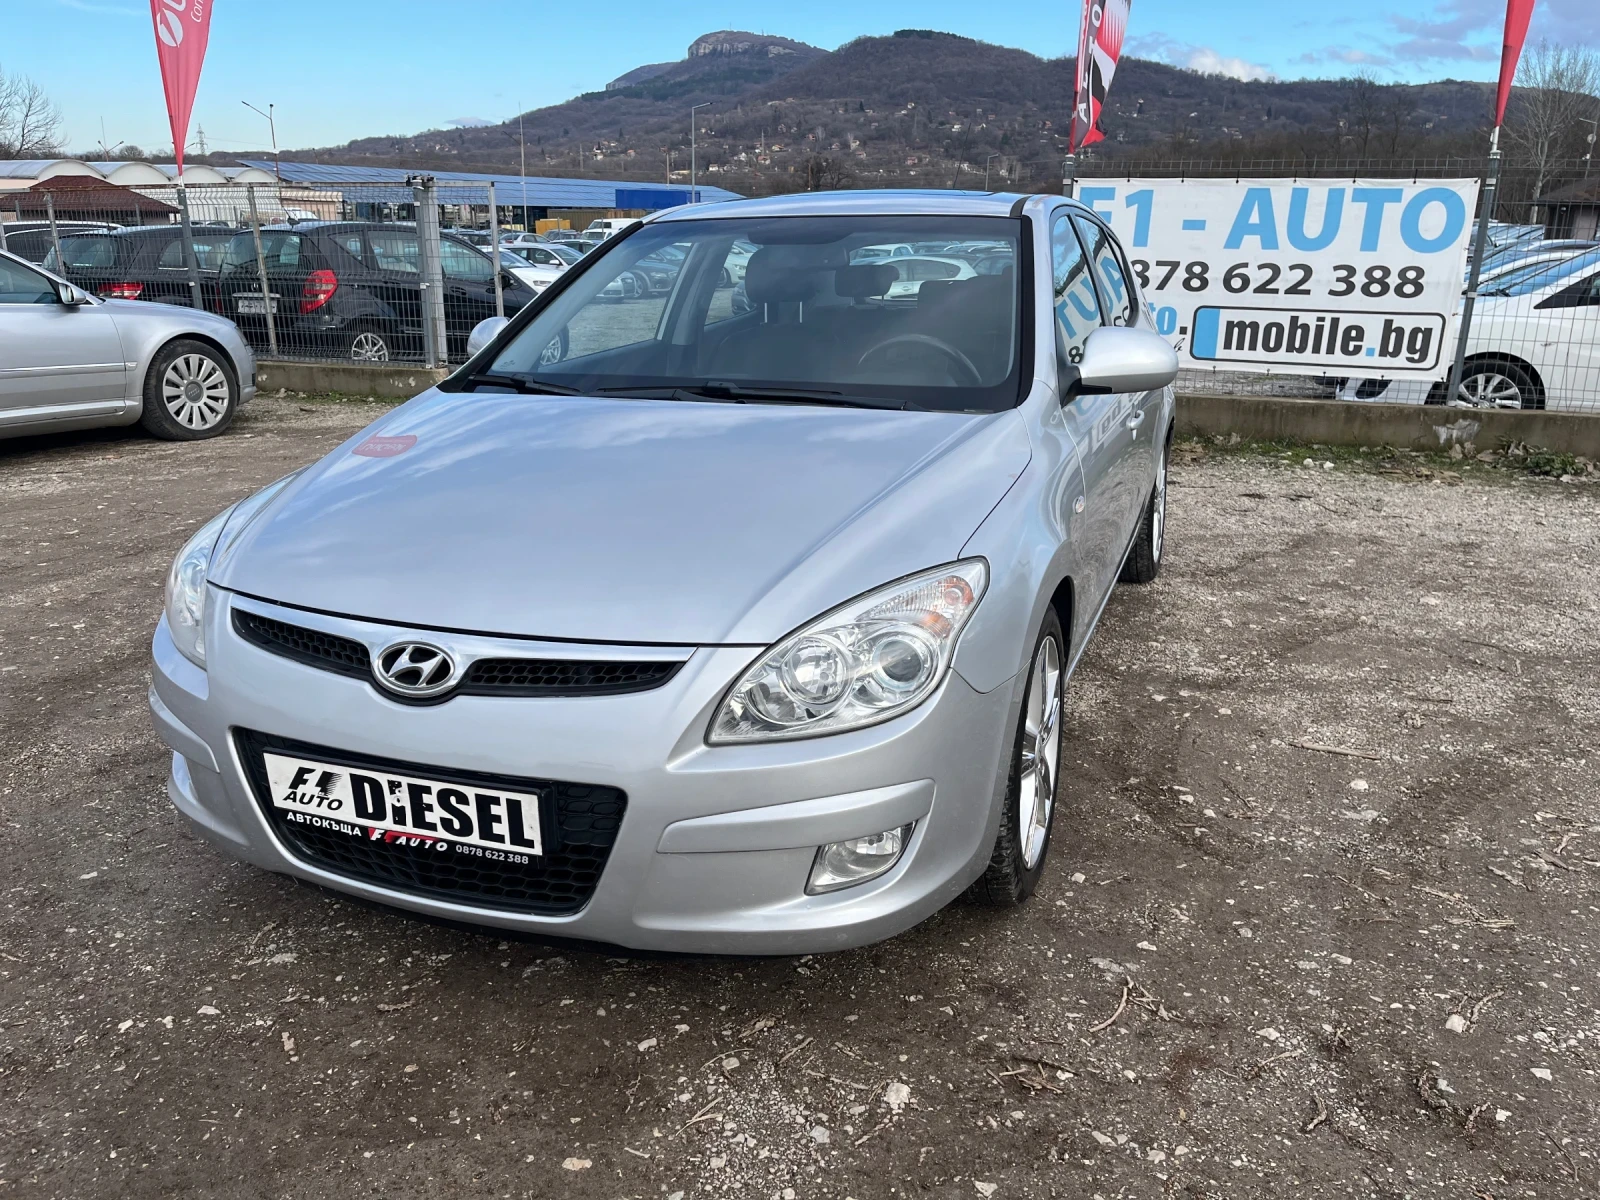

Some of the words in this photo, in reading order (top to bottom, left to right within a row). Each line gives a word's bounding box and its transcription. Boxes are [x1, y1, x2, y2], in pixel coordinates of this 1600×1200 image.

[1079, 187, 1154, 247] F1
[1223, 187, 1466, 253] AUTO
[1222, 262, 1313, 295] 622
[1327, 264, 1425, 299] 388
[1223, 316, 1433, 364] mobile.bg
[288, 766, 342, 796] F1
[282, 790, 343, 811] AUTO
[287, 811, 362, 837] АВТОКЪЩА
[395, 836, 448, 851] AUTO
[455, 844, 483, 857] 0878
[485, 849, 505, 861] 622
[507, 853, 529, 865] 388
